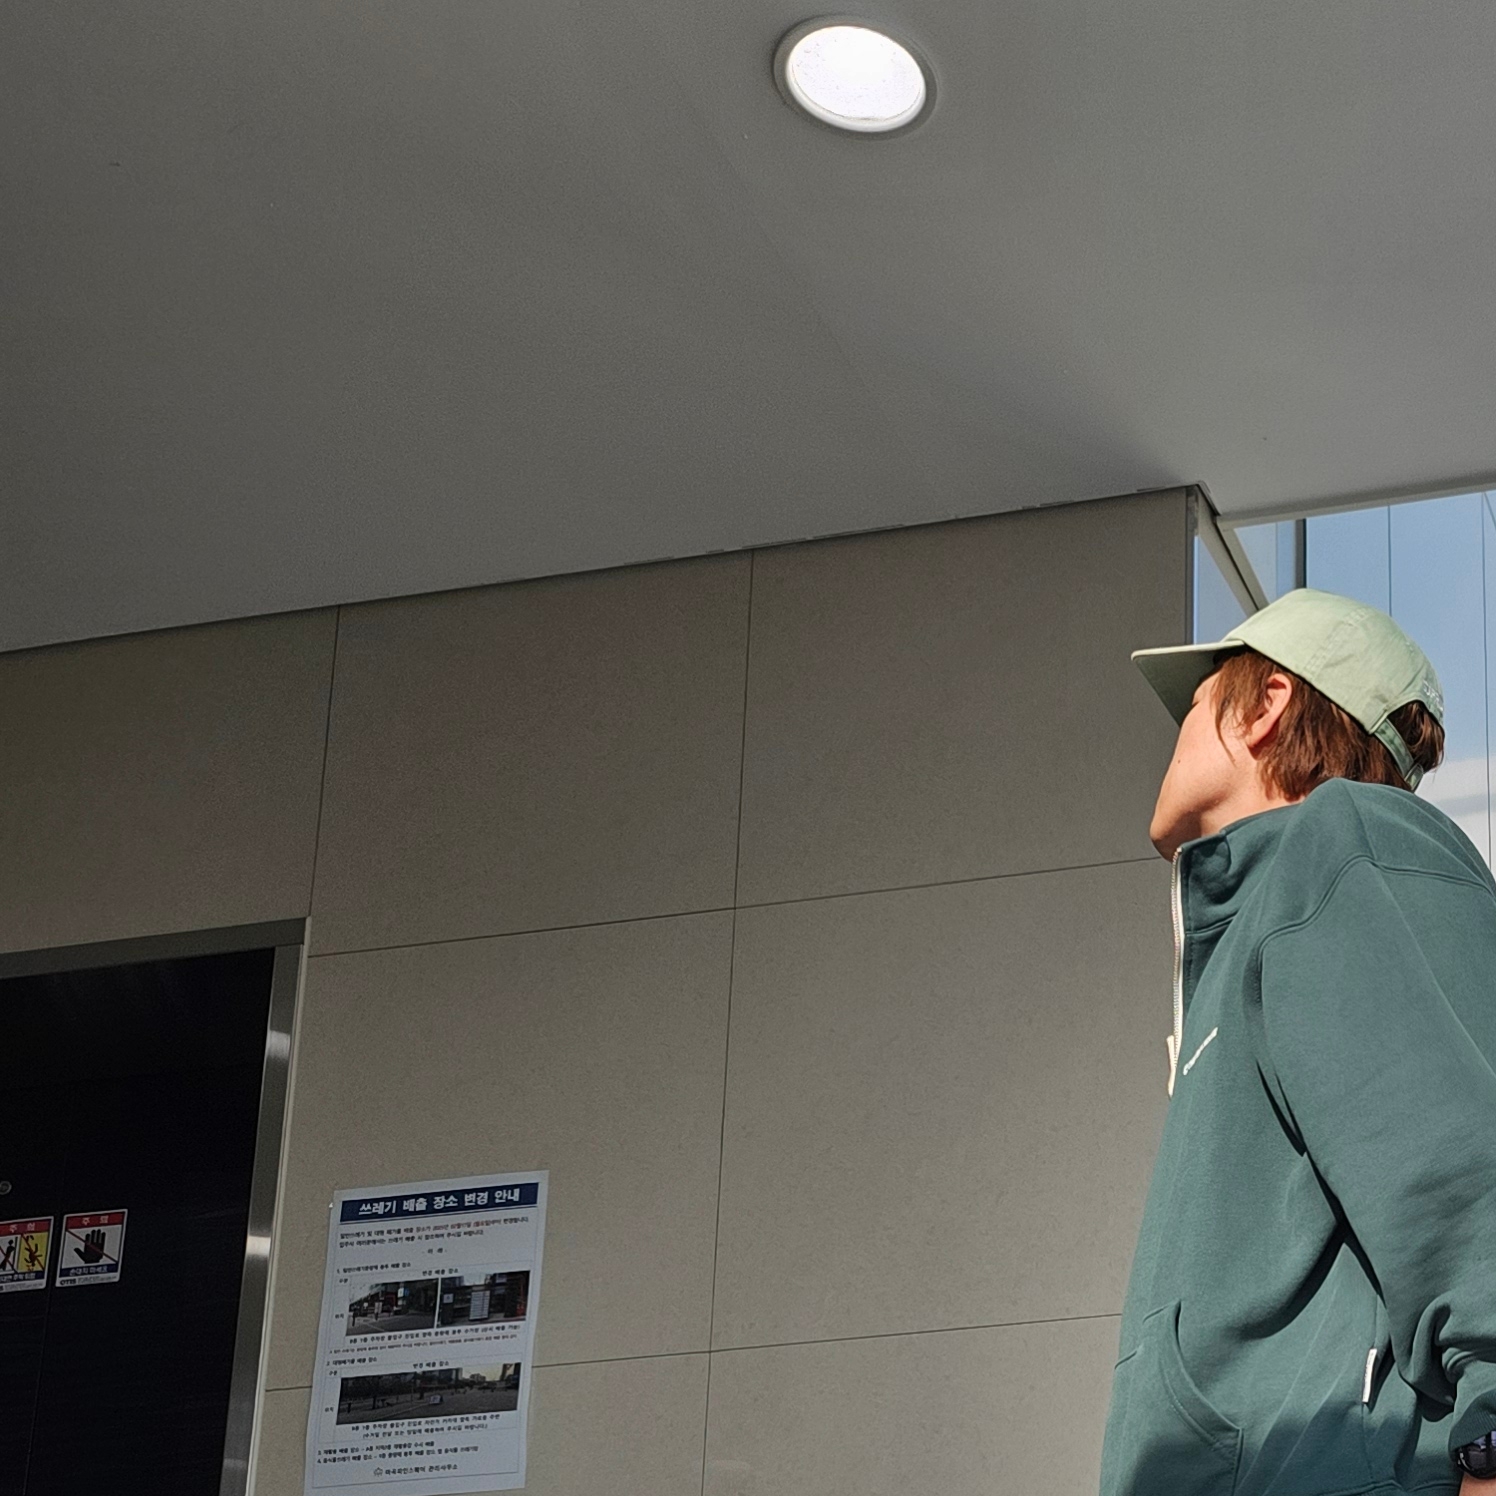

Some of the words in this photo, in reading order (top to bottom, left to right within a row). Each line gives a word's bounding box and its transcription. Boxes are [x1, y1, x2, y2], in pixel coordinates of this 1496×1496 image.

[358, 1200, 396, 1216] 쓰레기
[402, 1197, 428, 1212] 배출
[433, 1194, 459, 1209] 장소
[464, 1191, 488, 1206] 변경
[494, 1188, 520, 1203] 안내
